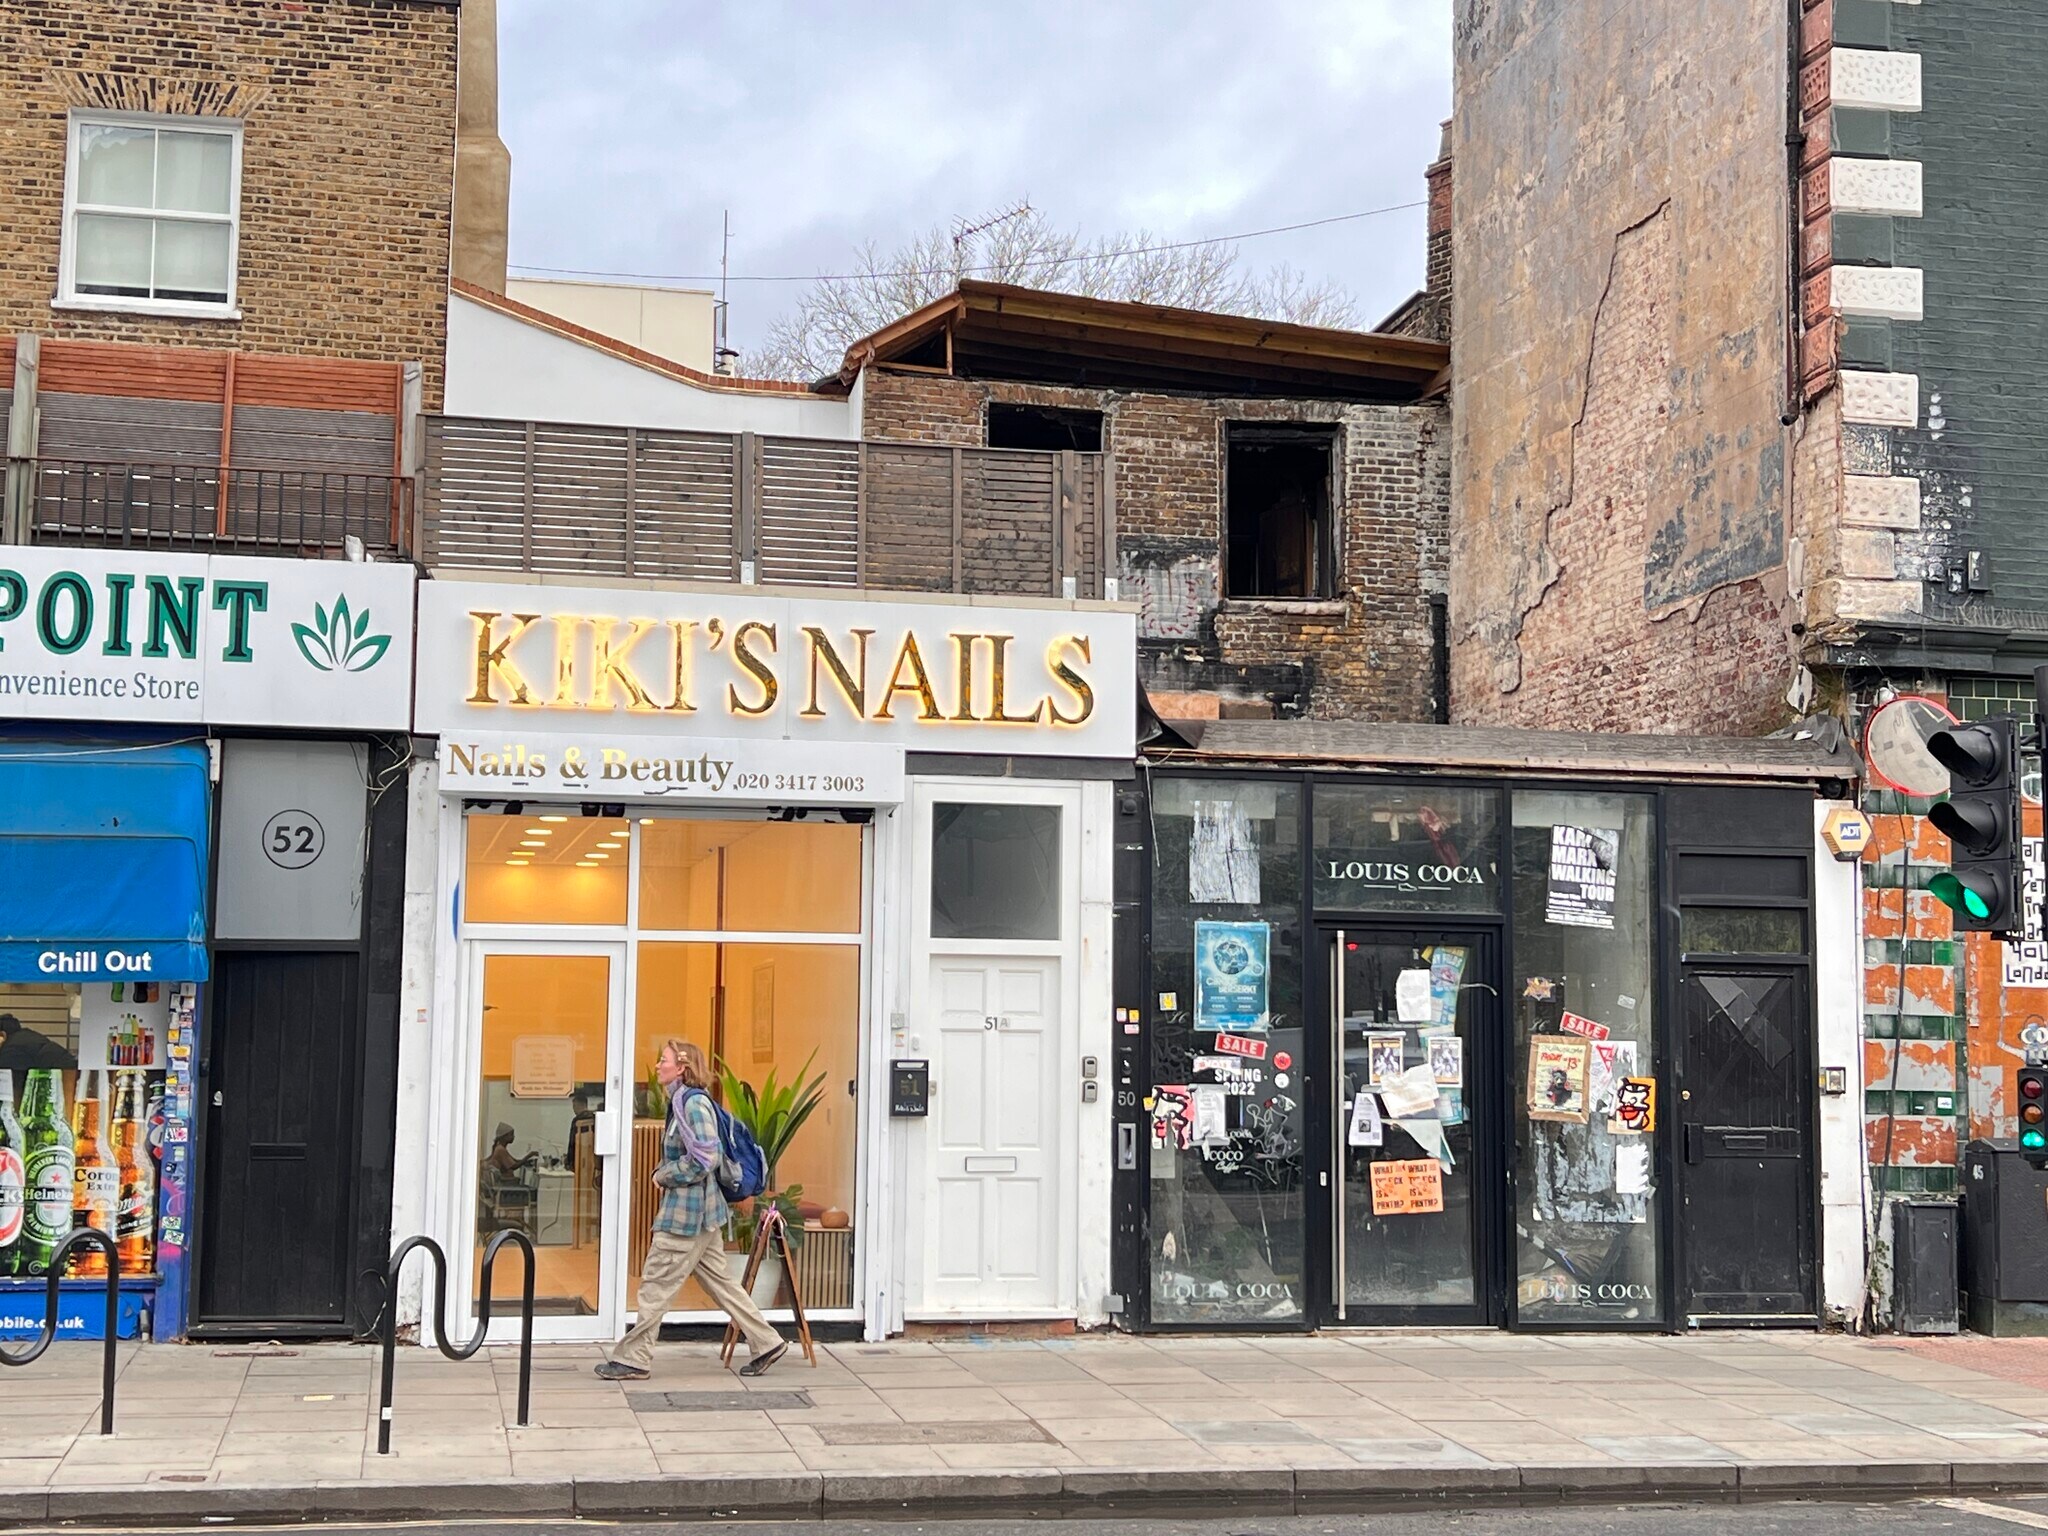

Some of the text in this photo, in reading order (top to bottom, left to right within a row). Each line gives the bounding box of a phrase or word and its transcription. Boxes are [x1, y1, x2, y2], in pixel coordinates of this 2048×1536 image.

[466, 610, 1096, 728] KIKI'S NAILS
[133, 672, 200, 699] Store
[447, 743, 866, 793] Nails & Beauty 020 3417 3003
[272, 825, 315, 854] 52
[1841, 825, 1860, 837] ADT
[1329, 861, 1485, 885] LOUIS COCA
[1551, 863, 1617, 887] WALKING
[1579, 883, 1615, 902] TOUR
[37, 950, 152, 973] Chill Out
[1566, 1017, 1602, 1039] SALE
[1221, 1036, 1259, 1056] SALE
[1118, 1090, 1136, 1106] 50
[25, 1187, 73, 1200] Heinek
[1236, 1283, 1293, 1299] COCA
[1597, 1283, 1653, 1300] COCA
[0, 1316, 84, 1329] bile.c.uk
